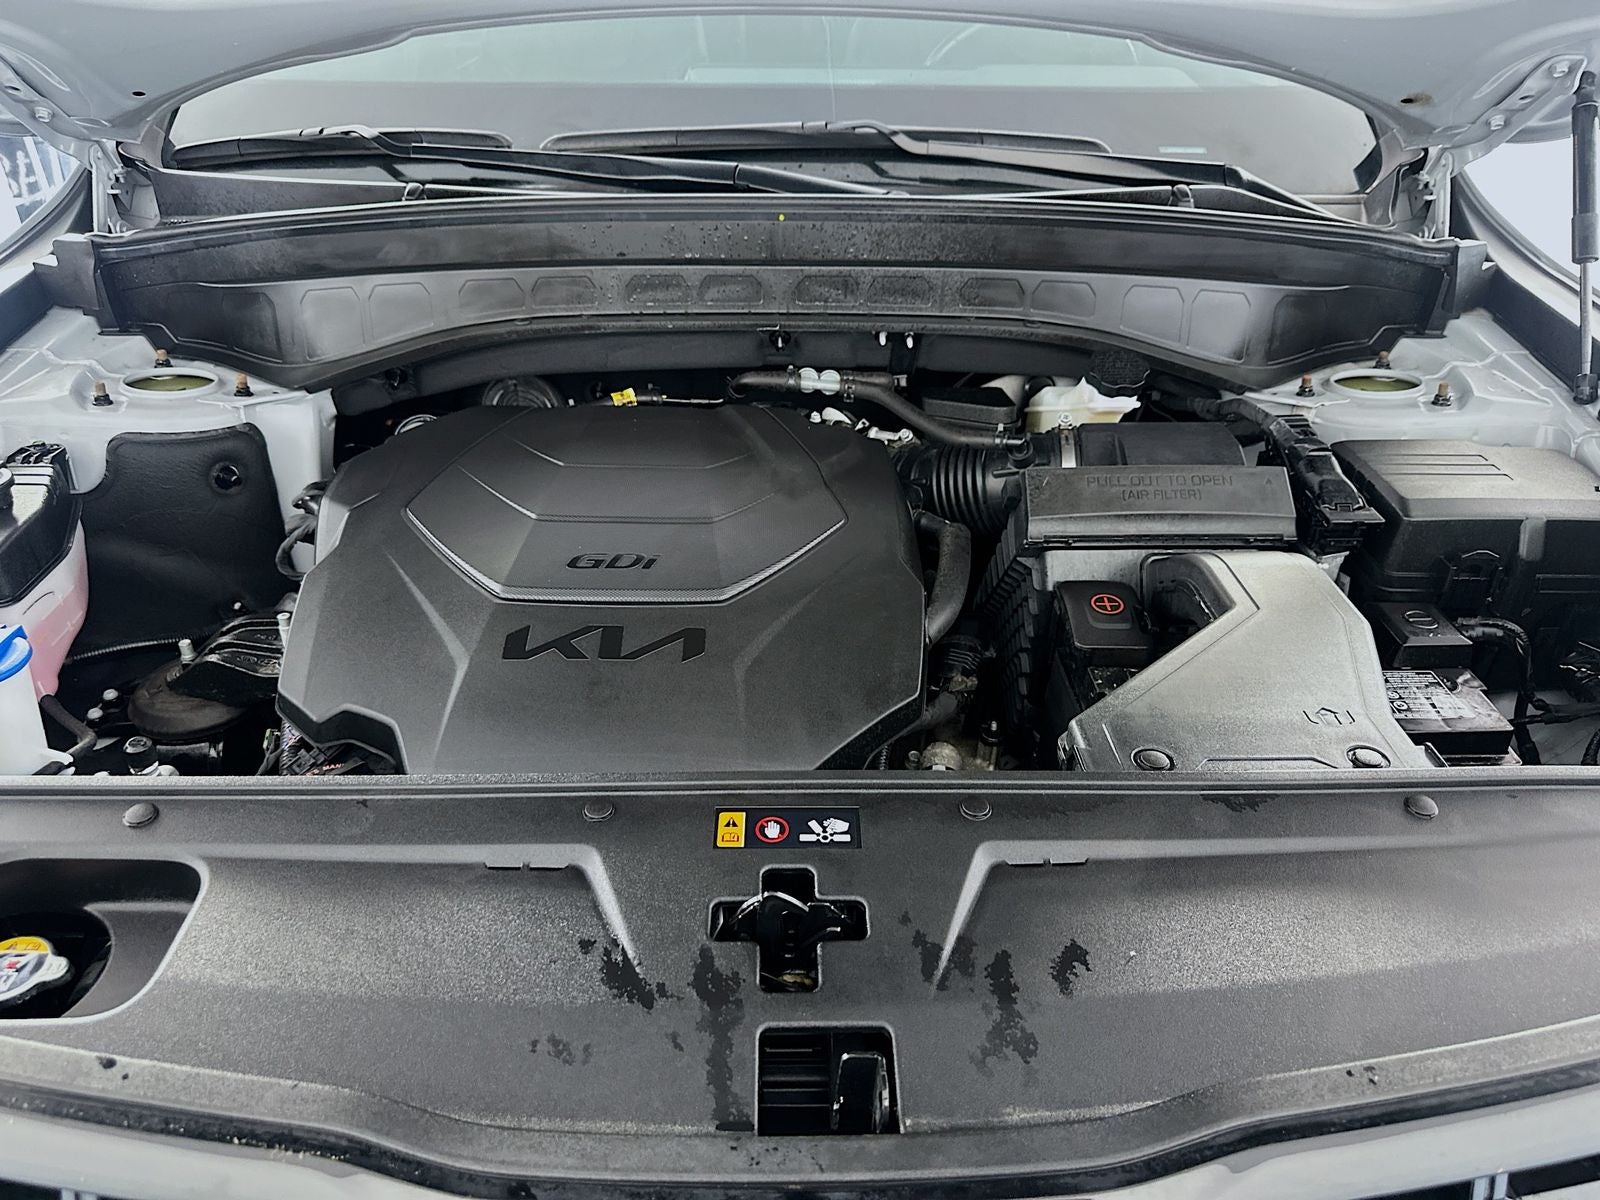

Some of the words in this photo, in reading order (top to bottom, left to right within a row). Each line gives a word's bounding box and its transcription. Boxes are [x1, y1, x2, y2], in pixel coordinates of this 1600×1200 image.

[1086, 474, 1128, 488] PULL
[1130, 474, 1161, 487] OUT
[1165, 474, 1187, 487] TO
[1190, 474, 1233, 487] OPEN
[1121, 489, 1150, 501] (AIR
[1153, 489, 1202, 501] FILTER)
[565, 552, 661, 570] GDi
[502, 624, 707, 663] KIA
